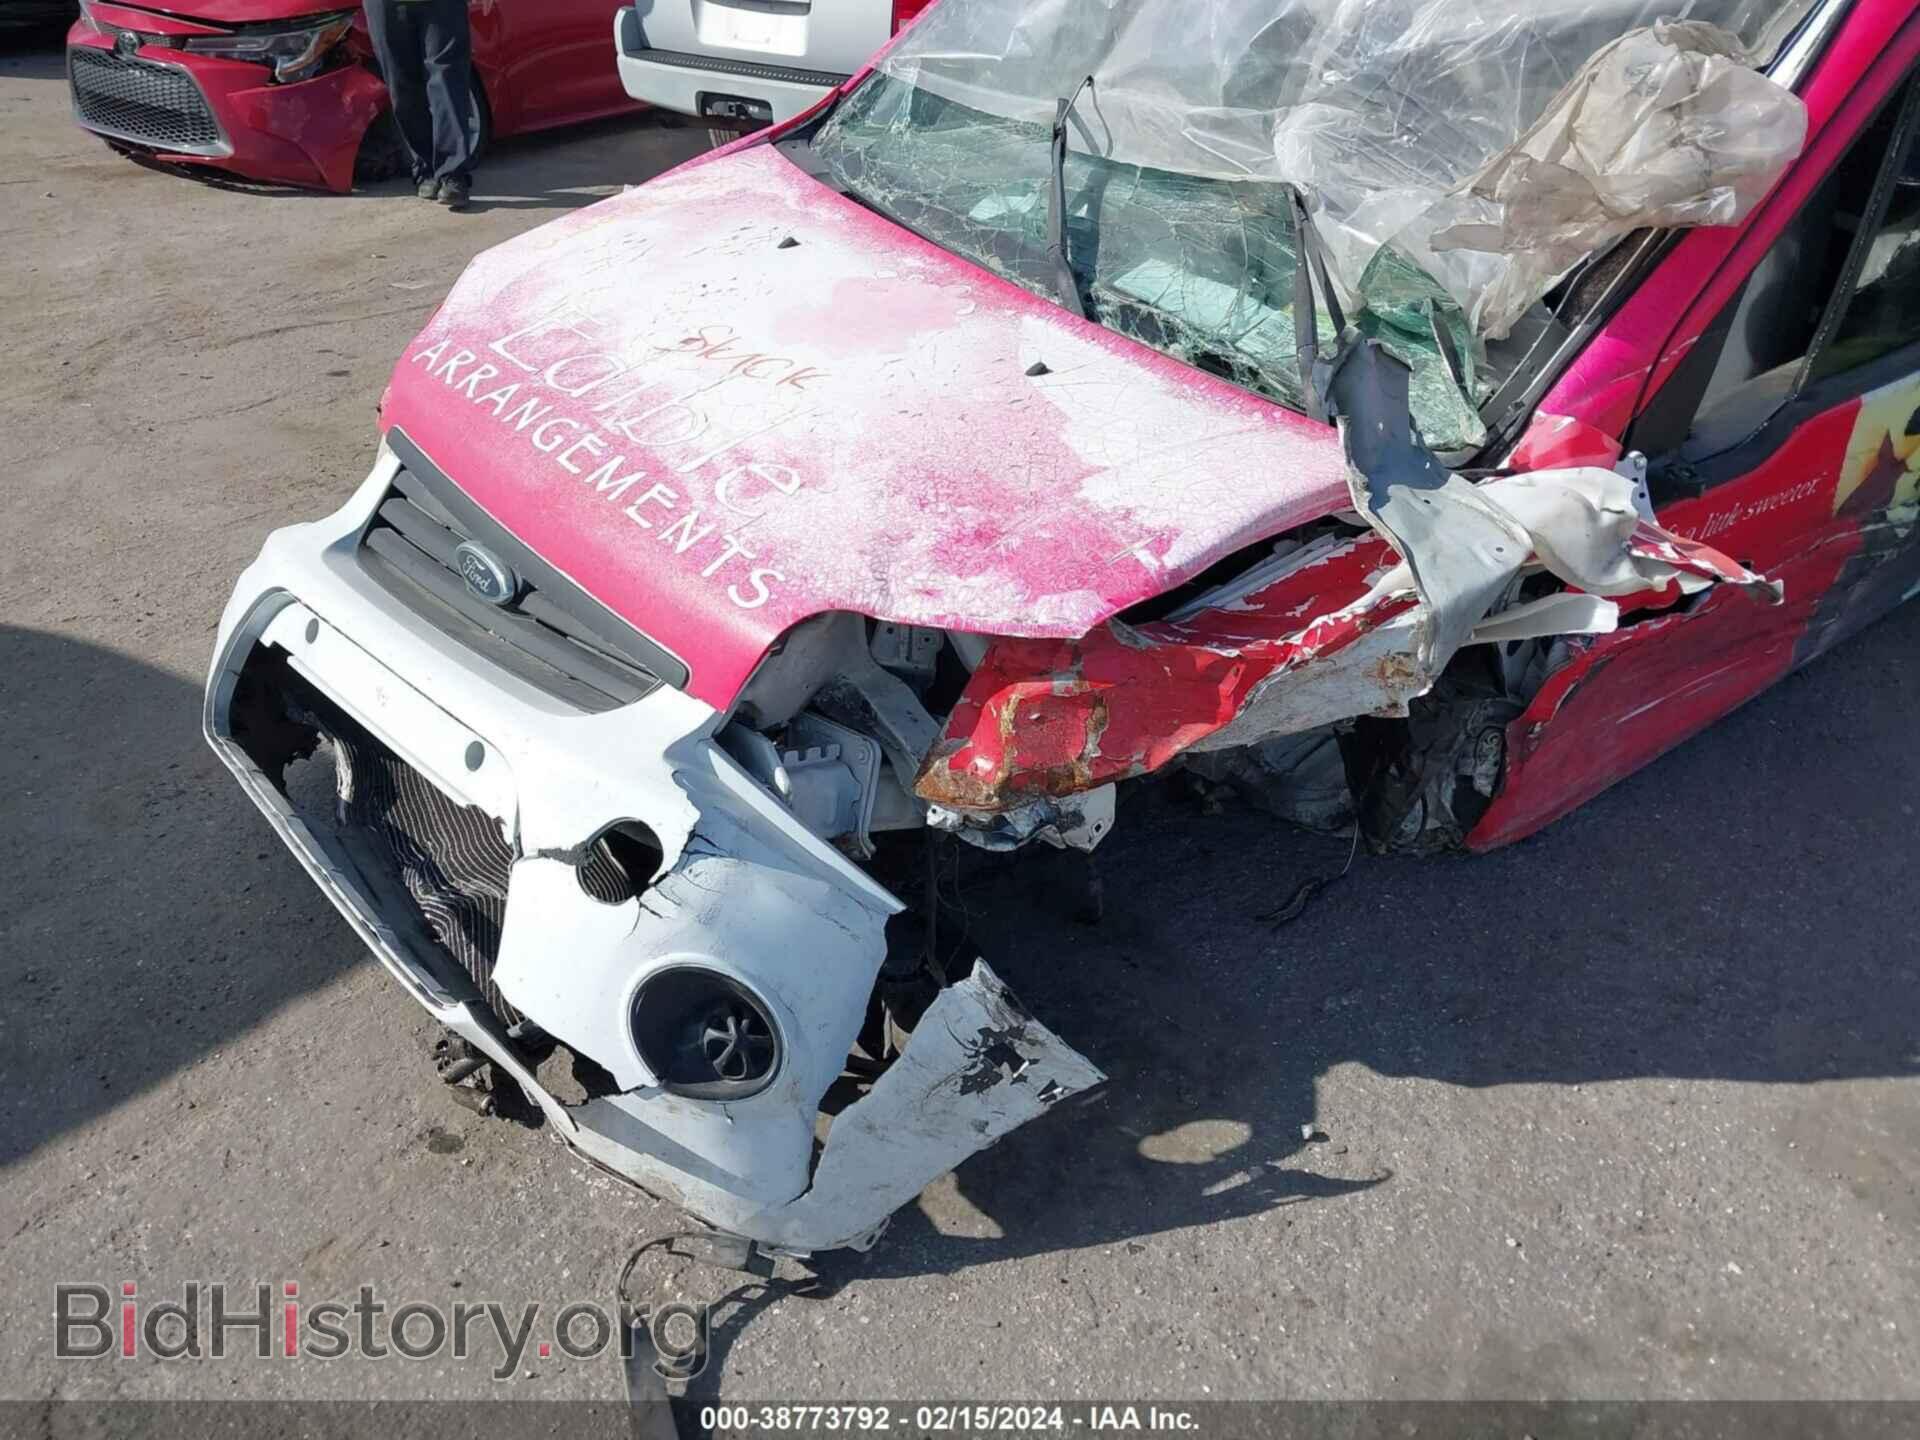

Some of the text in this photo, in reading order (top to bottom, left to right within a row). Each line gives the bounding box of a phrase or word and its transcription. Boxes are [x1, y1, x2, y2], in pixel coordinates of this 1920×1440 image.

[411, 340, 786, 609] ARRANGEMENTS
[488, 310, 806, 518] Edible
[1700, 502, 1740, 540] little
